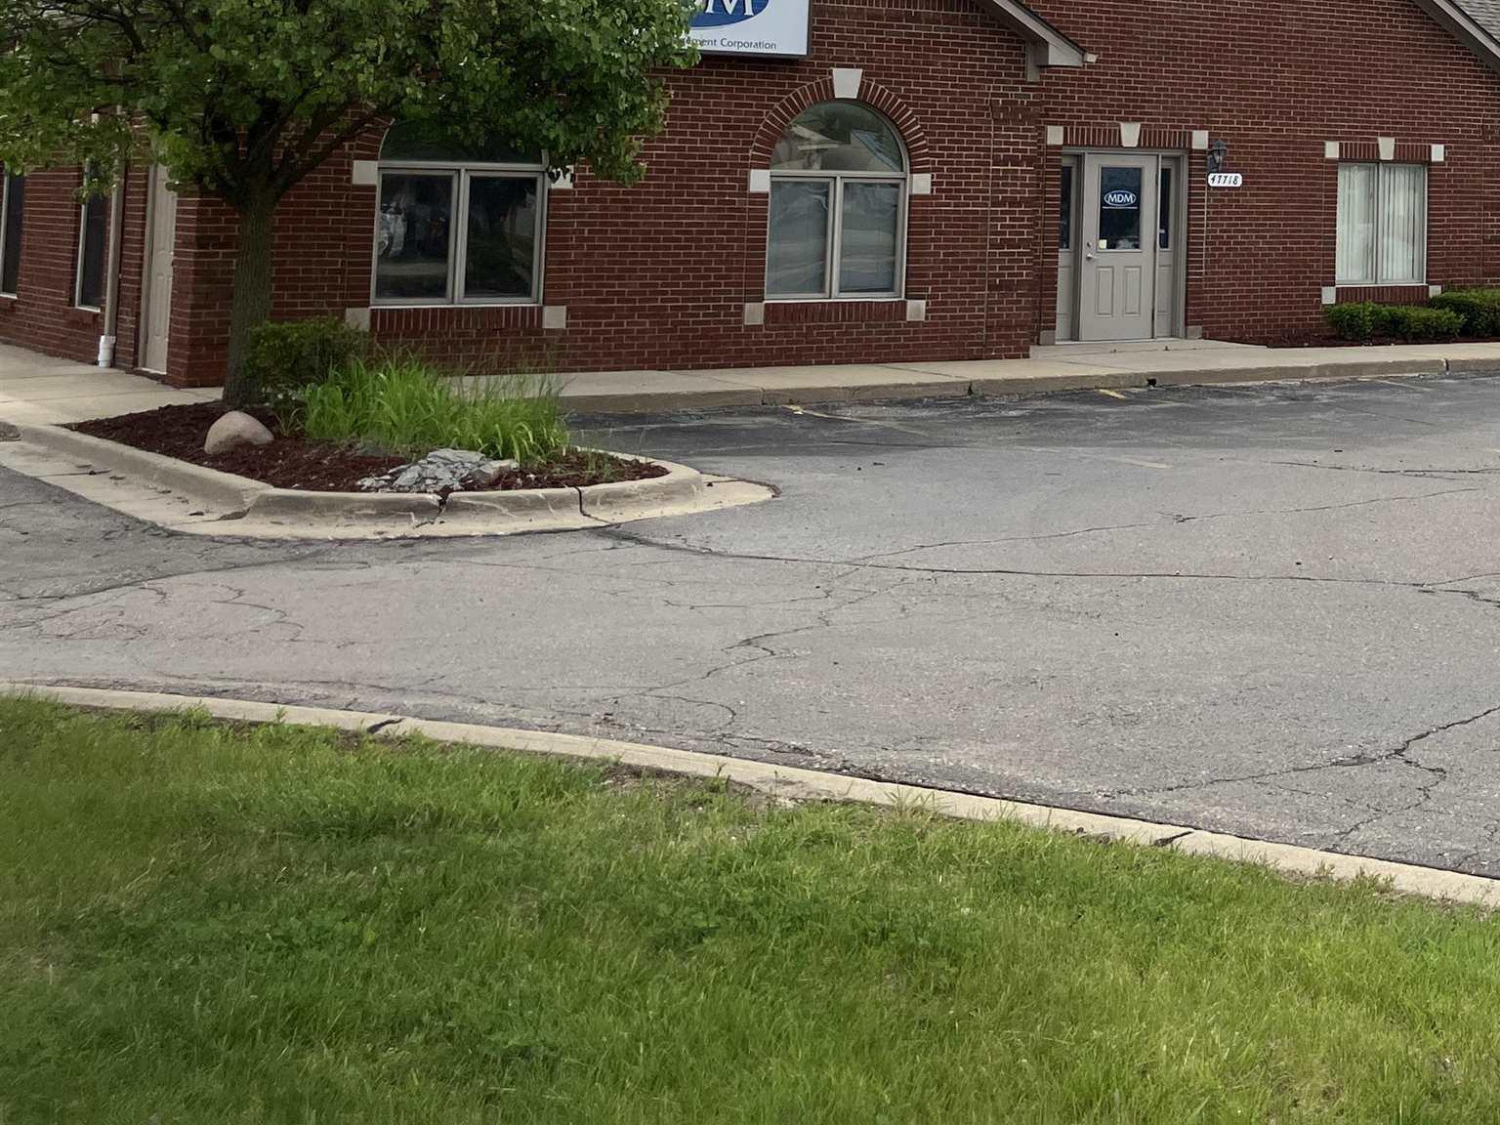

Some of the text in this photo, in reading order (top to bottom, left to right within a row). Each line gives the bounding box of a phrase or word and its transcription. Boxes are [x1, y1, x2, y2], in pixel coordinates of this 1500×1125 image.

[720, 37, 777, 50] Corporation
[1210, 175, 1239, 185] 47718
[1107, 194, 1133, 204] MDM
